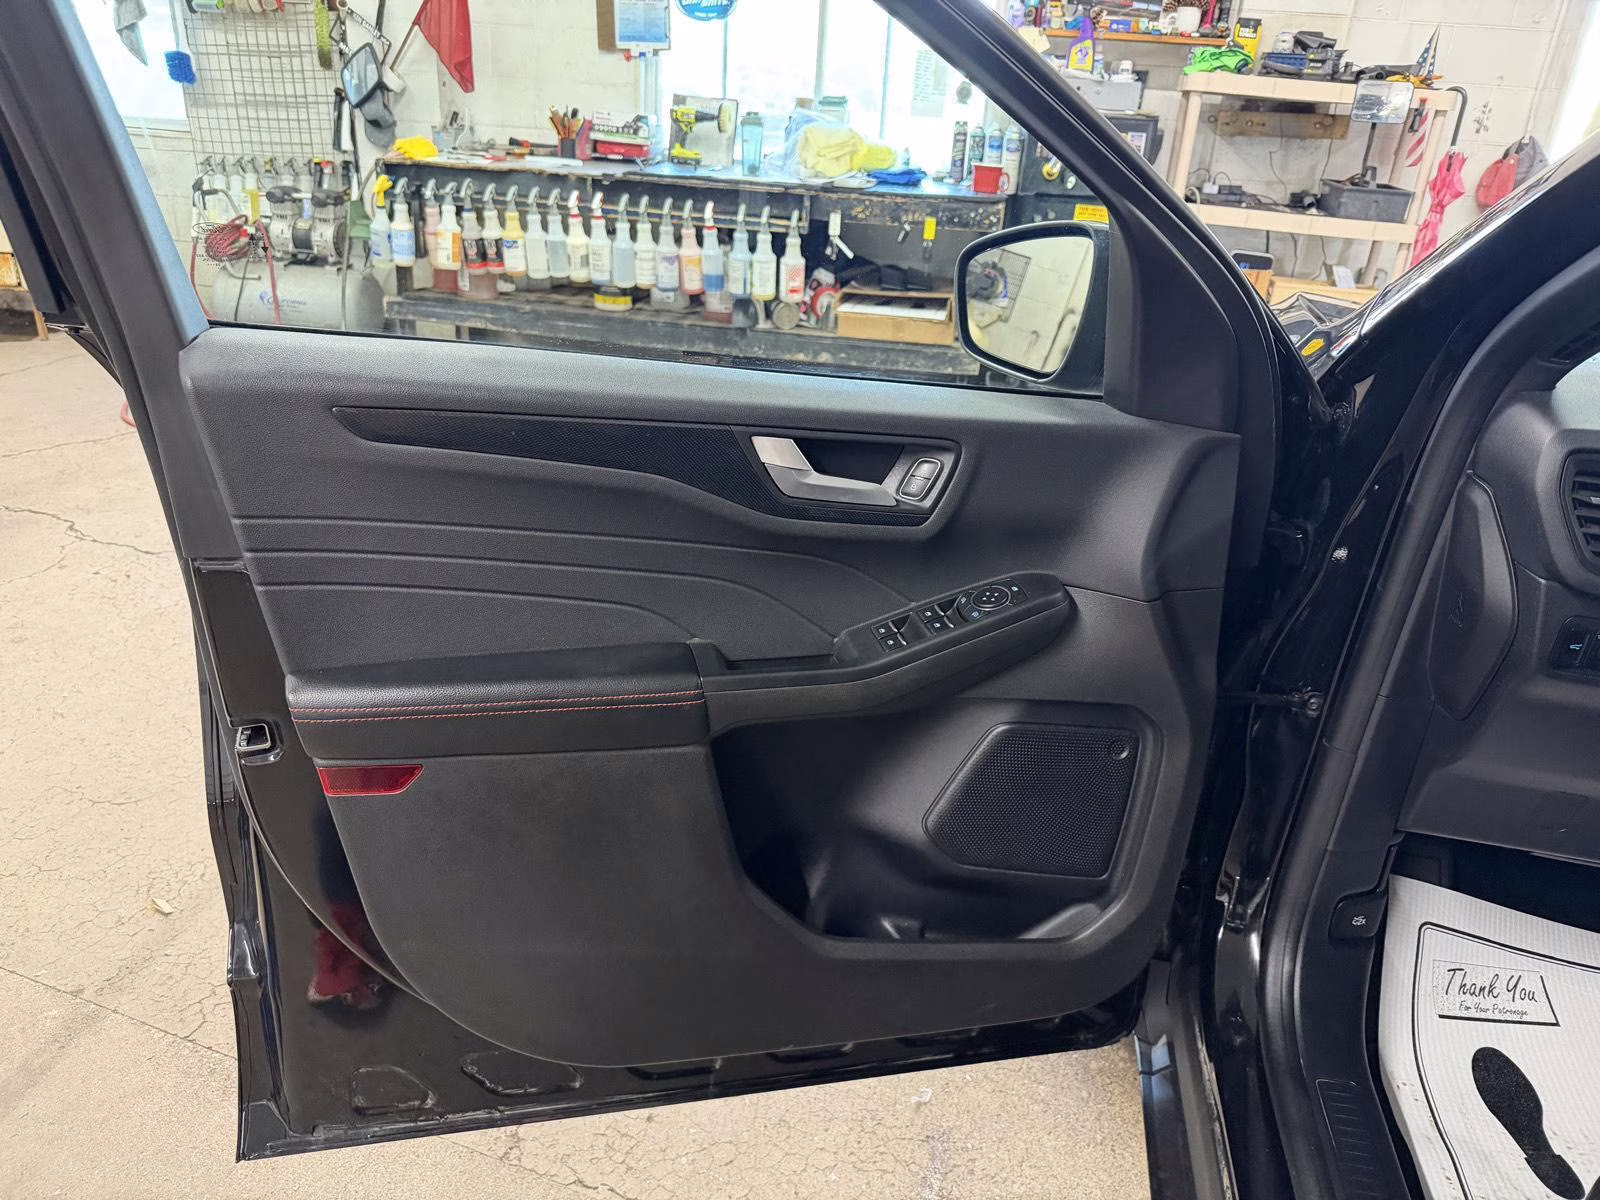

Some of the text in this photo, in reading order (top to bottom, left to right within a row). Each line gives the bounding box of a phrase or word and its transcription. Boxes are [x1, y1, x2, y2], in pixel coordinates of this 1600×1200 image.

[1445, 968, 1538, 1003] Thank You
[1459, 1000, 1529, 1019] For Your Patronage
